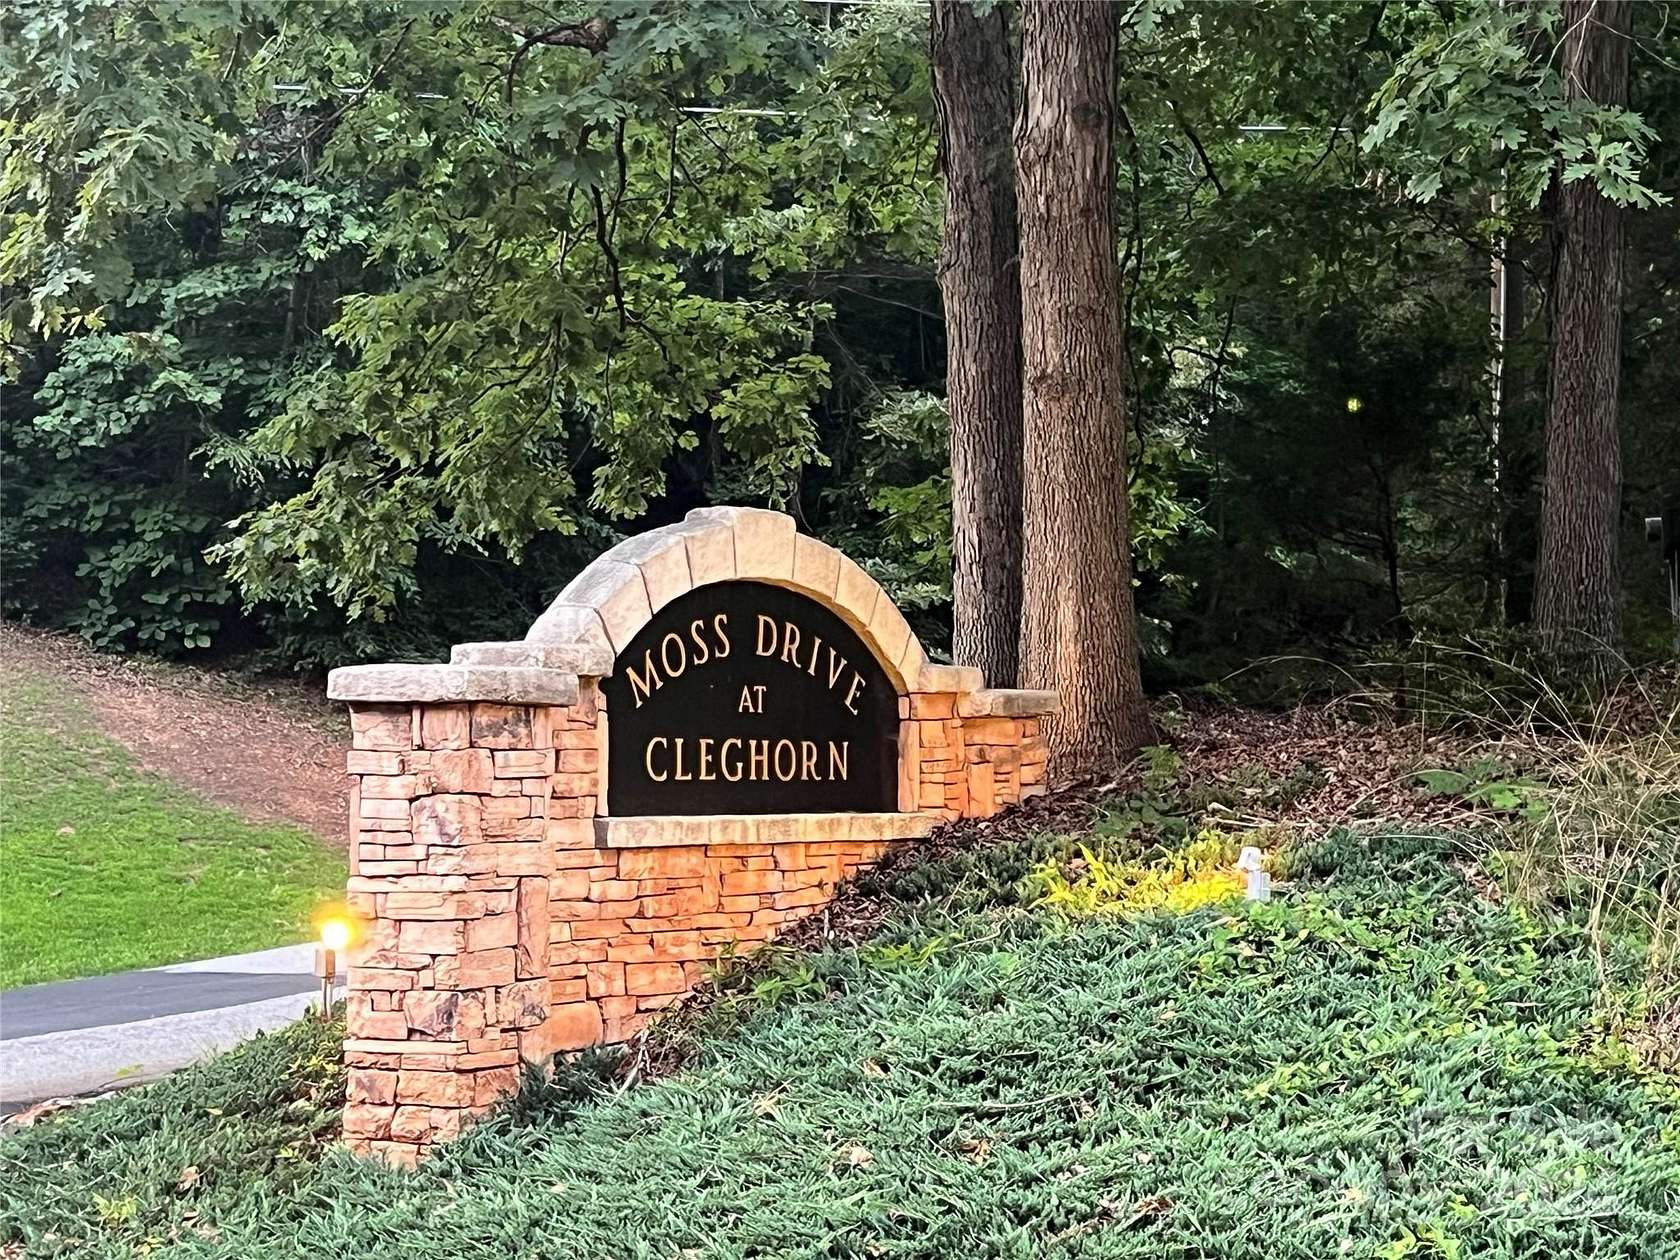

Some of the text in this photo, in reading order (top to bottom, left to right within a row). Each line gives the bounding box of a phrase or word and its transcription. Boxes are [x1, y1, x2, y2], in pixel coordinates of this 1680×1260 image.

[625, 613, 866, 716] MOSS DRIVE
[738, 684, 767, 714] AT
[645, 736, 849, 782] CLEGHORN
